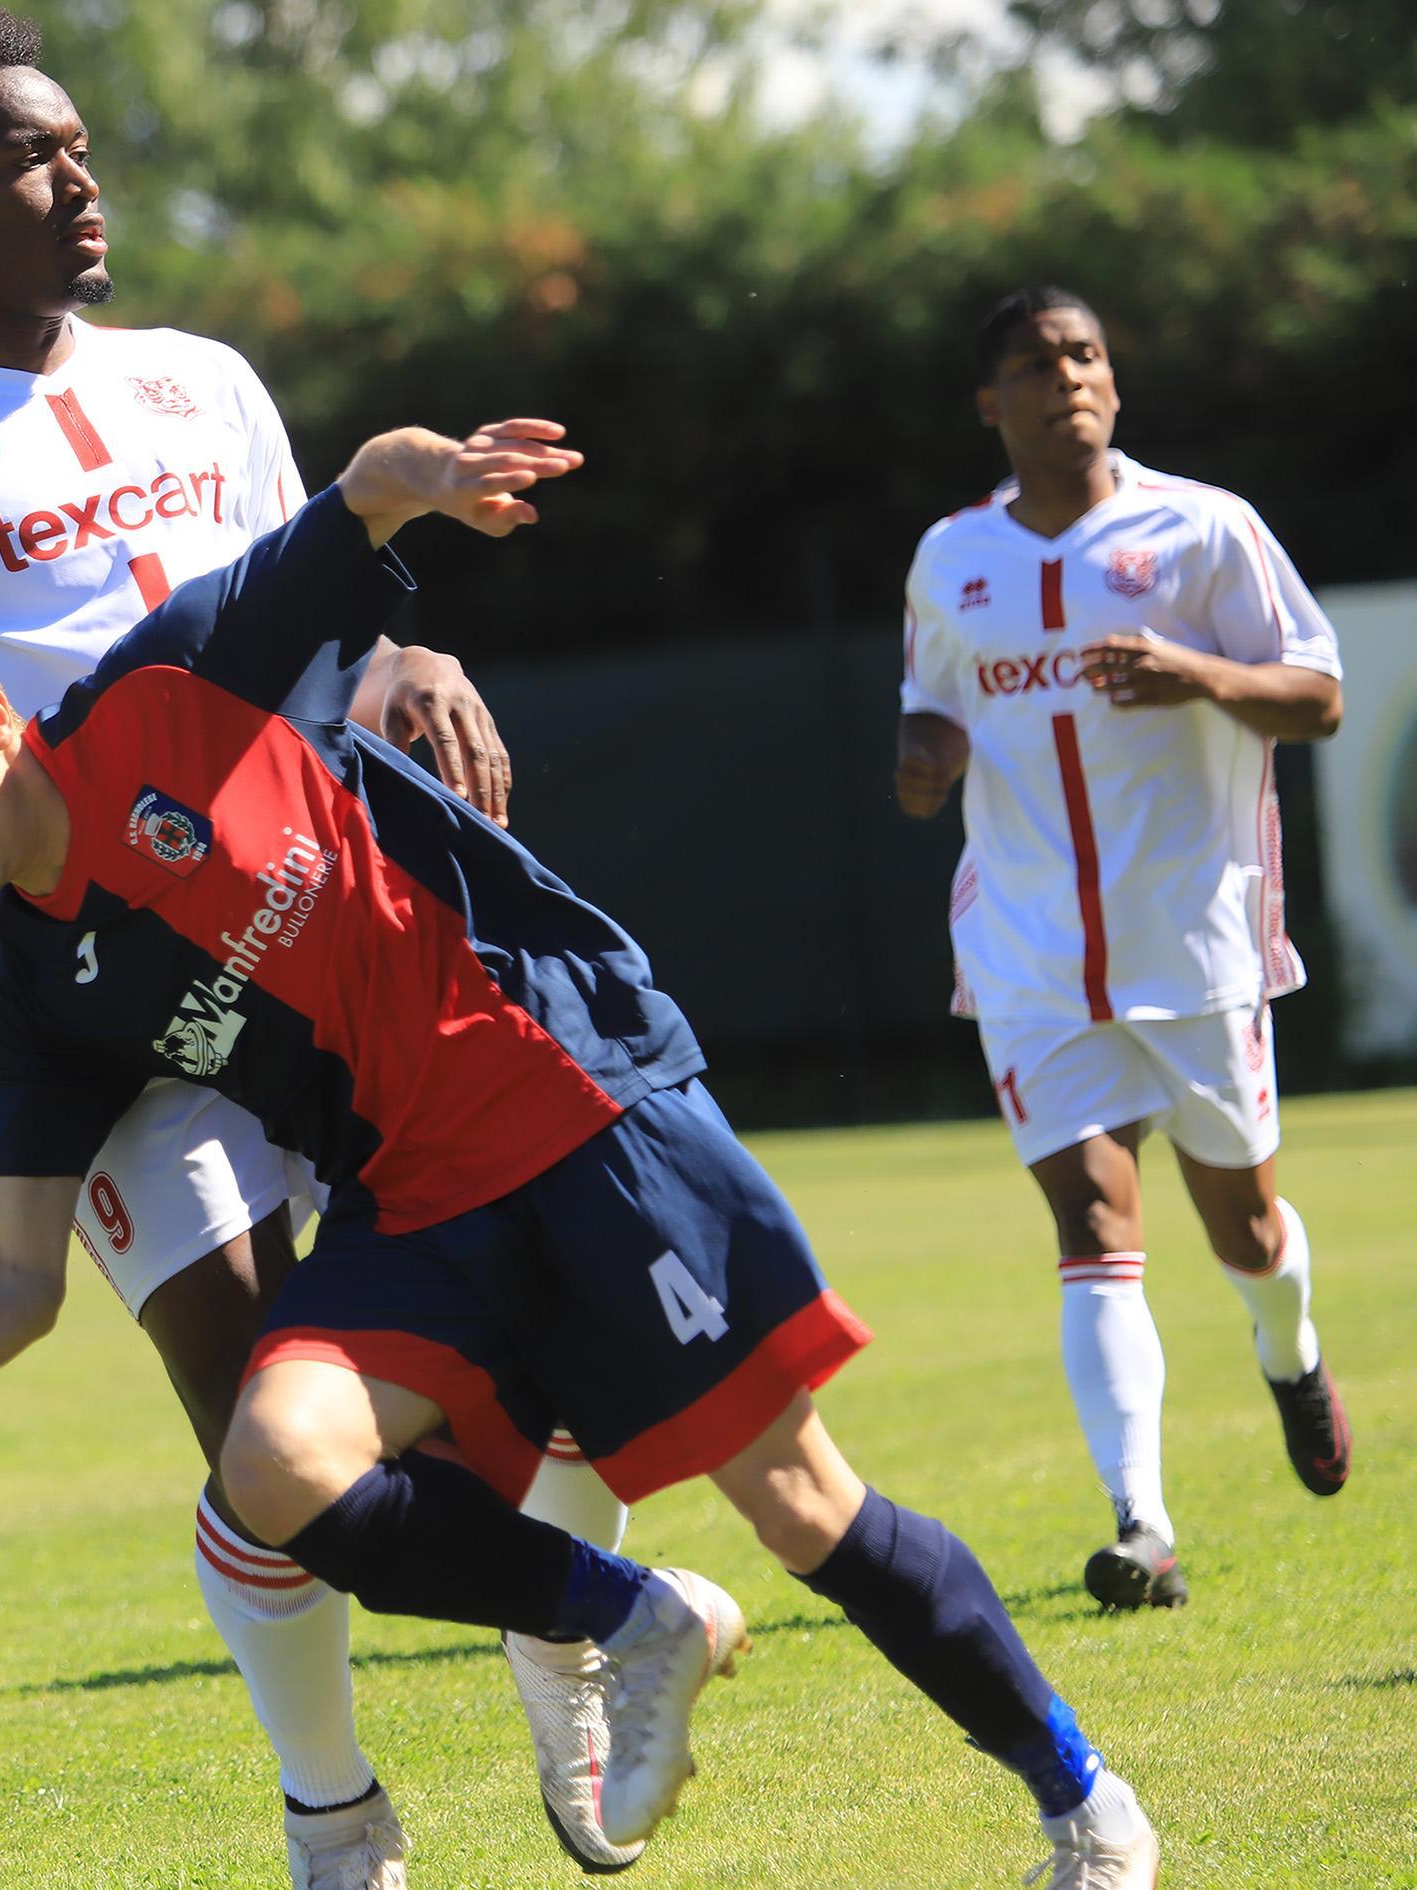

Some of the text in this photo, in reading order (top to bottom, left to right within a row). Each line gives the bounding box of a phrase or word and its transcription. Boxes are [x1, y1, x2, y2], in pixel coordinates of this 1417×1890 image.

[277, 848, 339, 949] BULLONERIE
[87, 1170, 135, 1255] 9
[647, 1248, 731, 1346] 4
